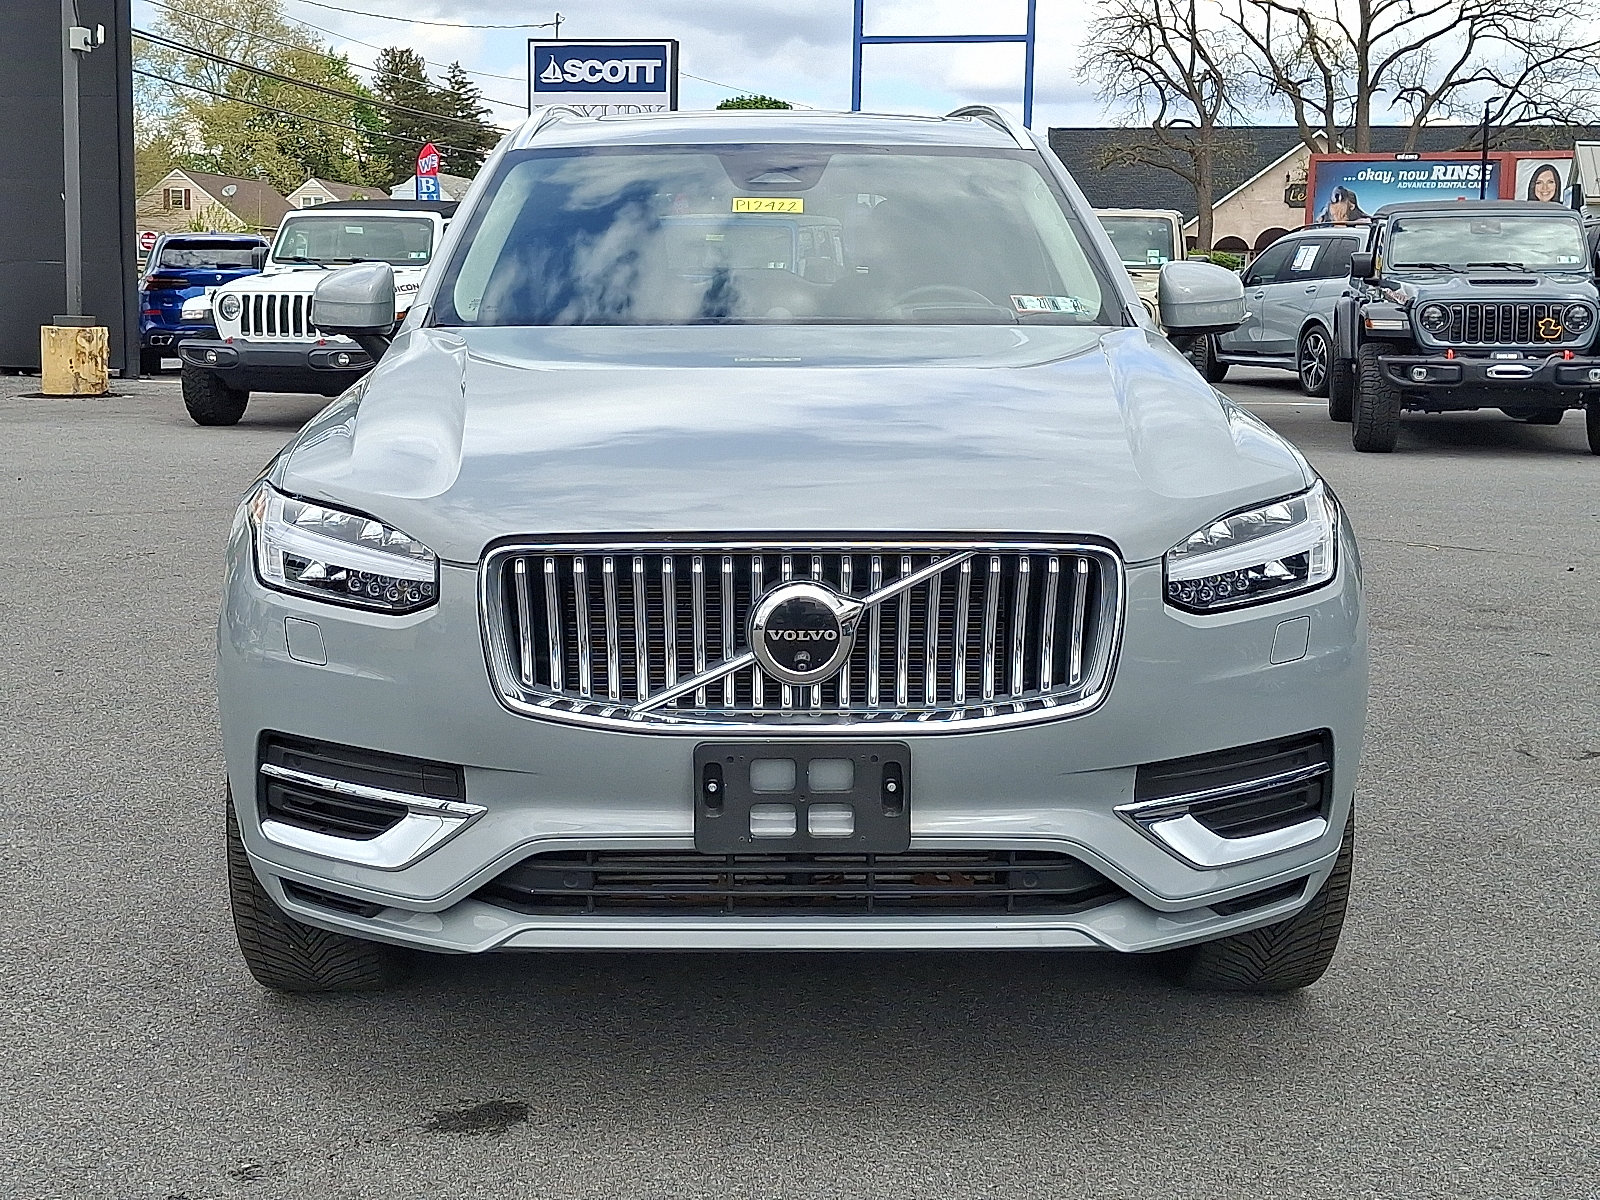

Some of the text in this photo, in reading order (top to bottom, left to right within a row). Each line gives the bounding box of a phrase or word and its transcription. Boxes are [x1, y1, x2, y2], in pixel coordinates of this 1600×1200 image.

[563, 59, 662, 84] SCOTT
[1398, 170, 1428, 180] now
[1396, 181, 1436, 189] ADVANCED
[1437, 181, 1467, 189] DENTAL
[766, 629, 838, 641] VOLVO
